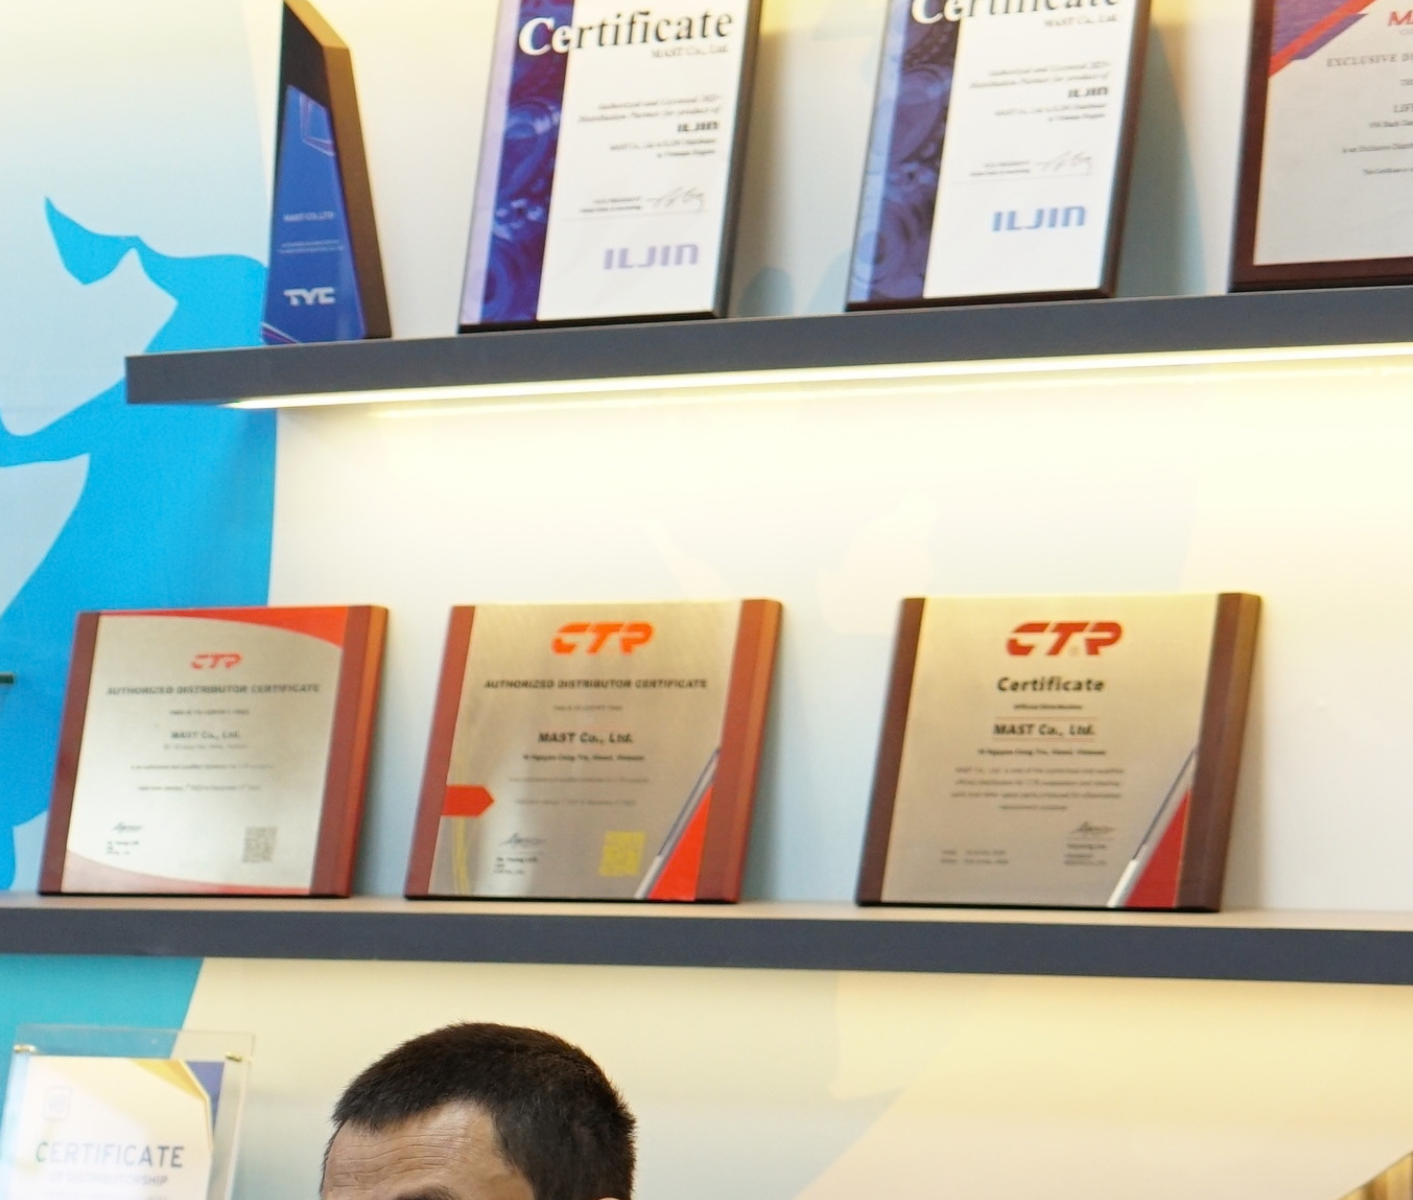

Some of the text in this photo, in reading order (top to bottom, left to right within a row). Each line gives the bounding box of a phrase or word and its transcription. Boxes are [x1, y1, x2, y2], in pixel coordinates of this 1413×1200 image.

[518, 10, 734, 55] Certificate
[991, 205, 1087, 233] ILJIN
[603, 242, 700, 270] ILJIN
[283, 286, 336, 306] TYC
[550, 620, 655, 656] CTR
[1005, 621, 1123, 656] CTR
[190, 653, 244, 670] CTR
[106, 683, 321, 696] AUTHORIZED DISTRIBUTOR CERTIFICATE
[483, 678, 708, 689] AUTHORIZED DISTRIBUTOR CERTIFICATE
[996, 676, 1106, 692] Certificate
[537, 732, 575, 743] MAST
[579, 732, 604, 745] Co.,
[992, 723, 1034, 735] MAST
[1037, 723, 1063, 737] Co.,
[36, 1141, 185, 1168] CERTIFICATE
